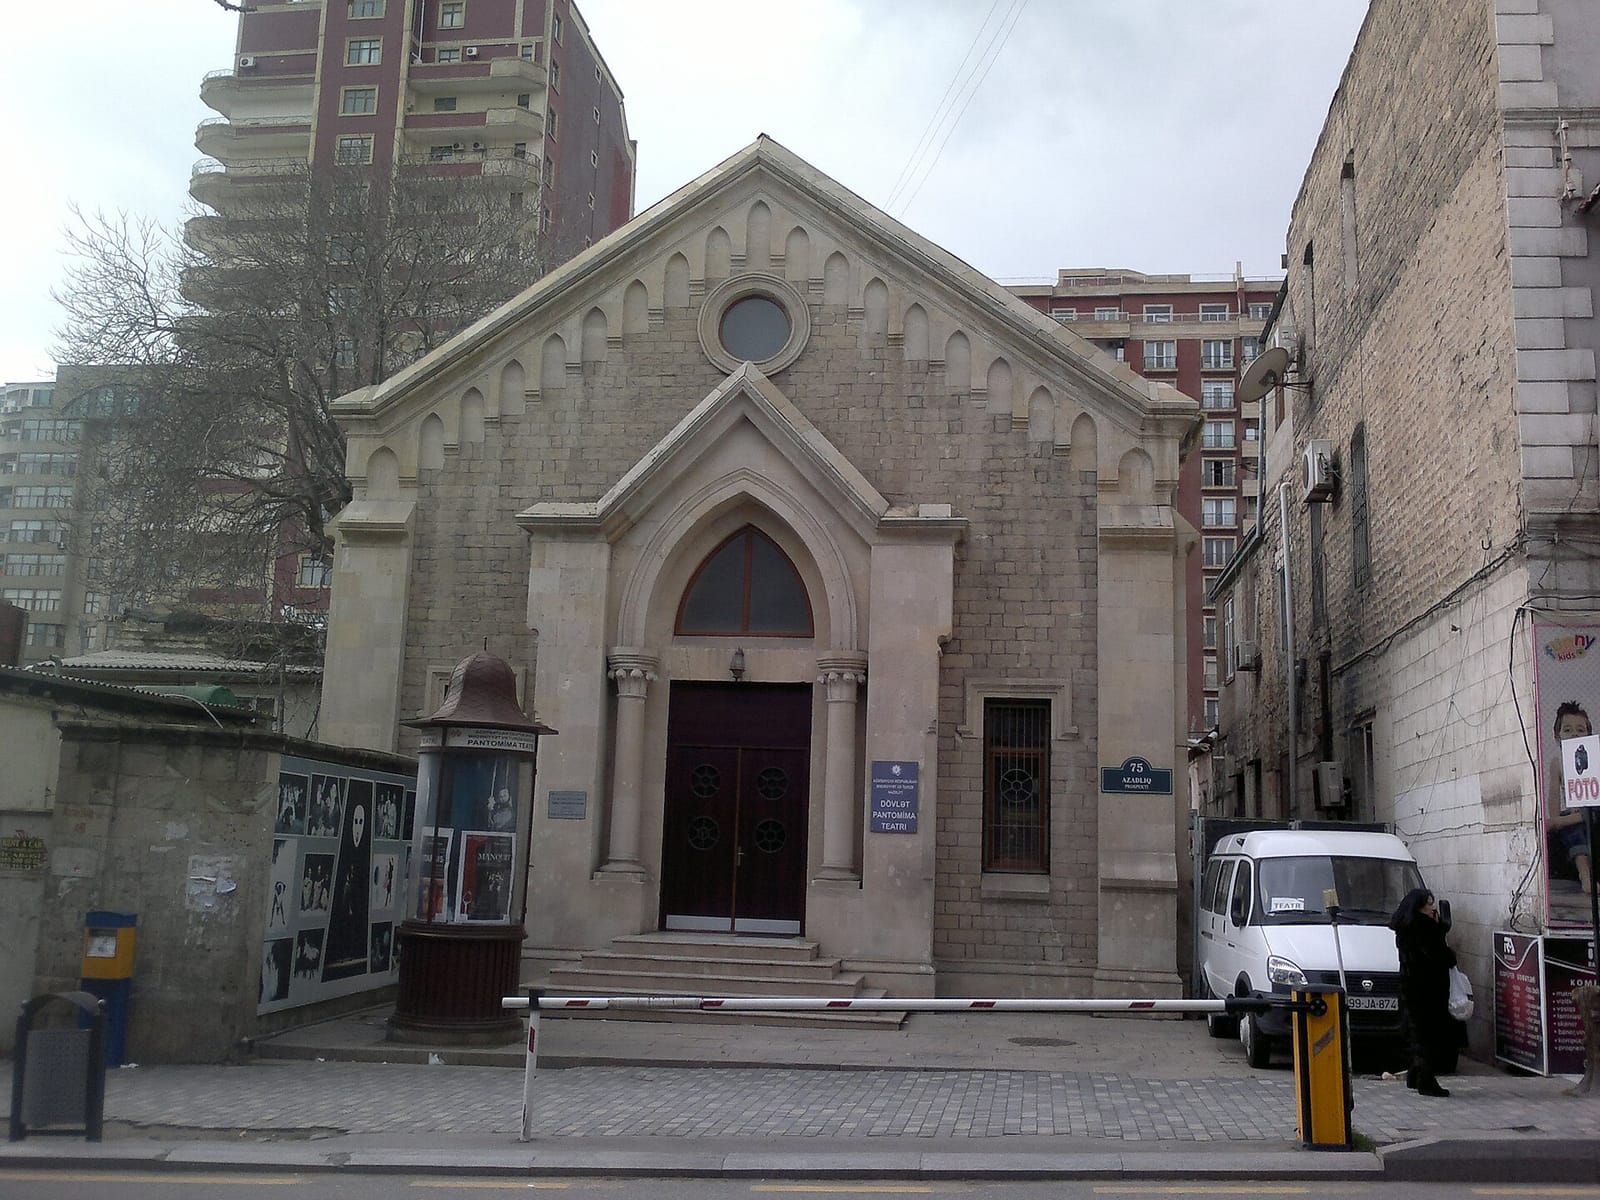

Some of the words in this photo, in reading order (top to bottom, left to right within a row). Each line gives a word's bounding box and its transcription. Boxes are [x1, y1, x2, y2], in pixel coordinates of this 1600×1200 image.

[1130, 763, 1144, 773] 75
[1122, 777, 1152, 785] AZADLIQ
[1568, 777, 1600, 801] FOTO
[873, 811, 917, 819] PANTOMİMA
[1349, 998, 1397, 1009] 99-JA-874
